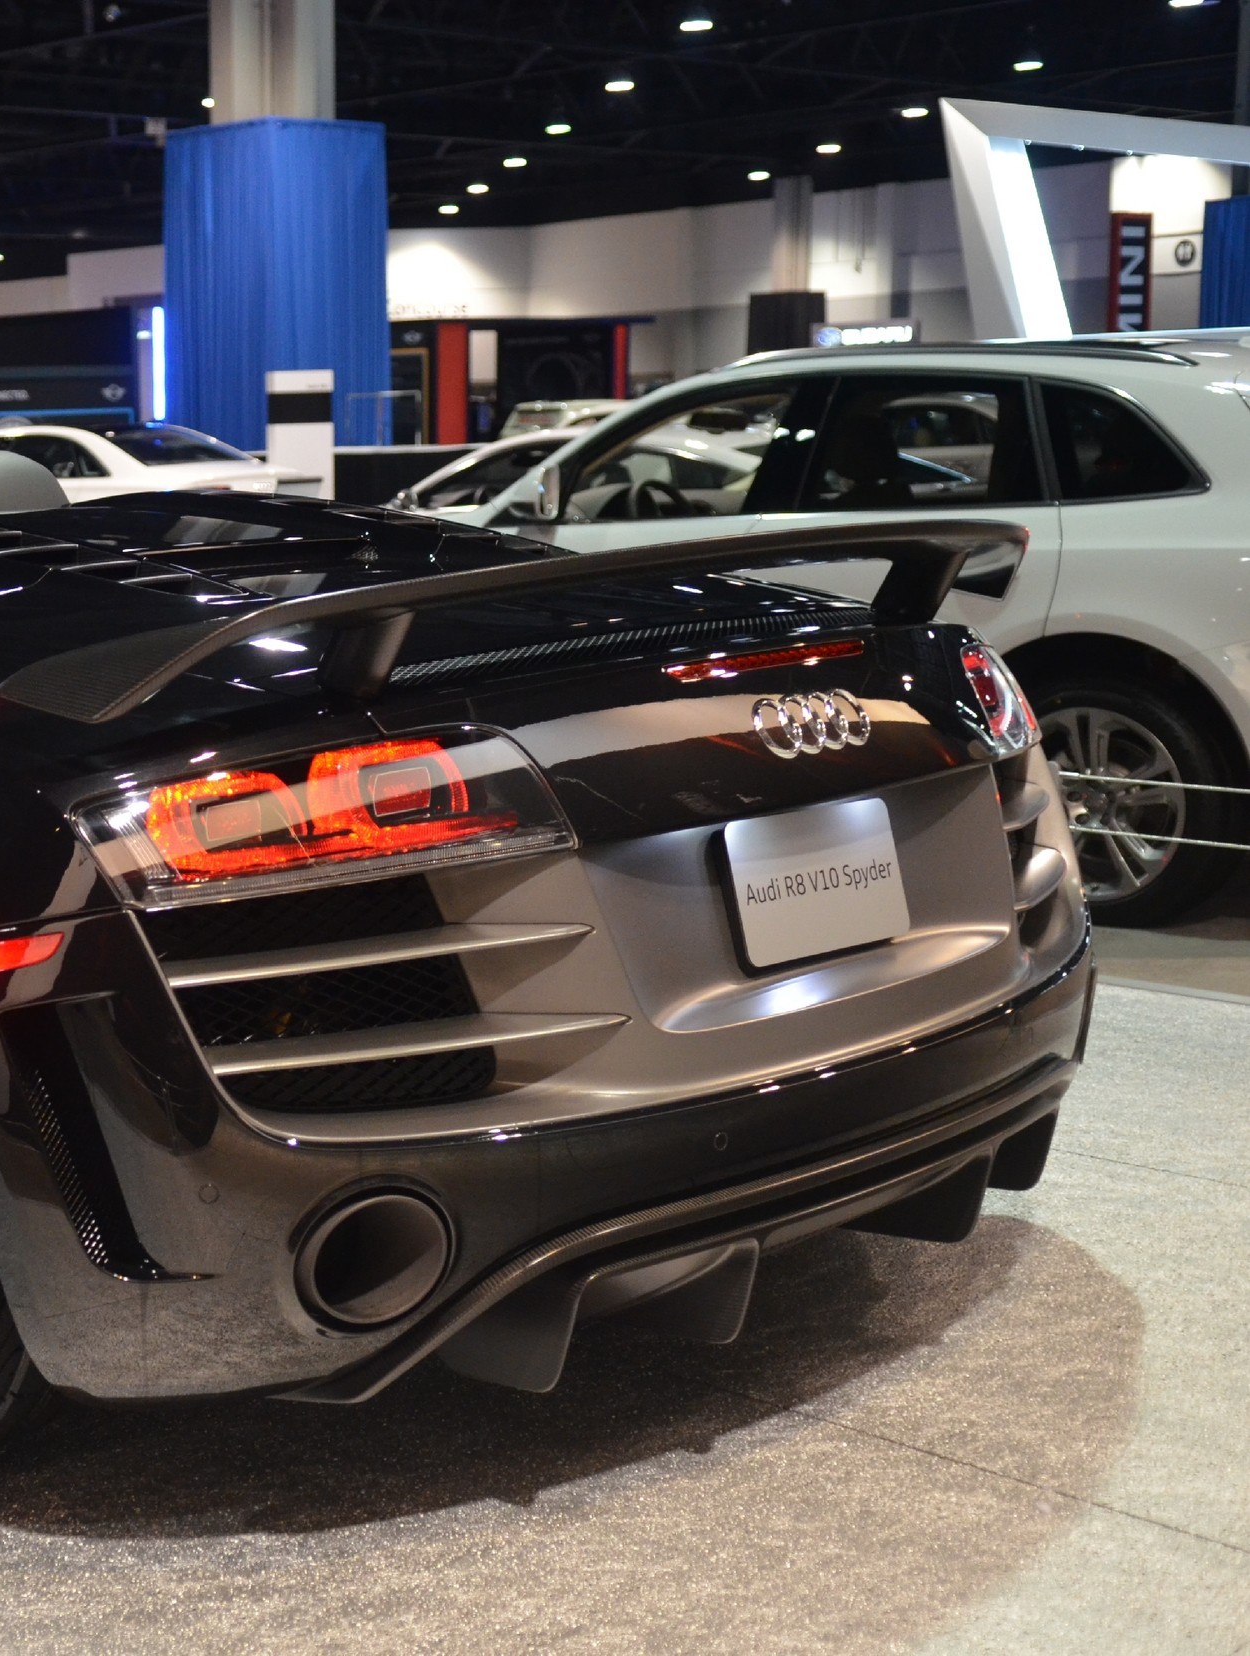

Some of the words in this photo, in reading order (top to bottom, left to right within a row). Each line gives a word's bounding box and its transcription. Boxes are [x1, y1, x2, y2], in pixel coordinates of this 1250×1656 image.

[746, 878, 782, 906] Audi
[785, 873, 807, 898] R8
[807, 867, 840, 892] V10
[843, 859, 892, 891] Spyder
